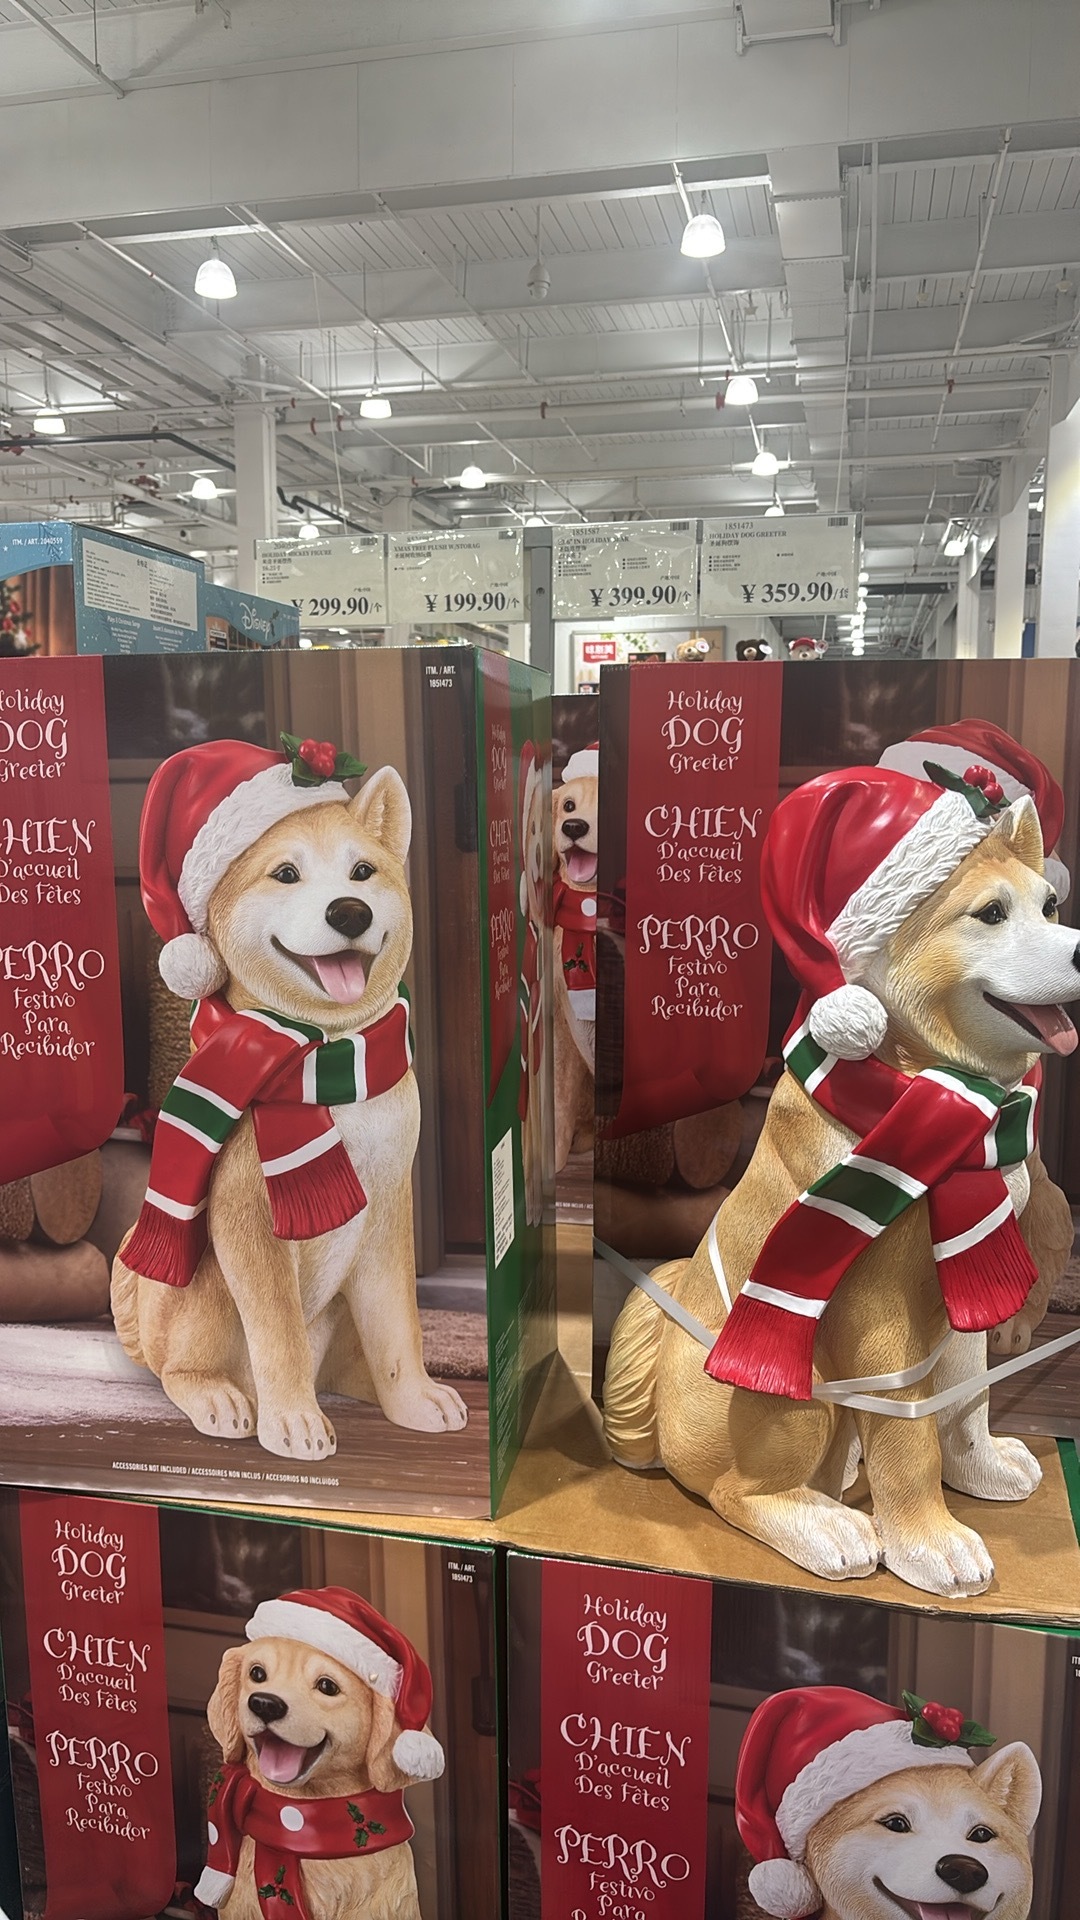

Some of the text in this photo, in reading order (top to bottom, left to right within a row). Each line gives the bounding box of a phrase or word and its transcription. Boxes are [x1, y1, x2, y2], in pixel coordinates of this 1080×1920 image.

[725, 522, 754, 530] 1851473
[424, 594, 438, 612] ¥
[590, 588, 604, 607] ¥
[741, 584, 756, 604] ¥
[426, 666, 438, 674] ITM.
[443, 665, 456, 674] ART.
[430, 678, 452, 688] 1851473
[0, 688, 64, 716] oliday
[668, 690, 742, 715] Holiday
[661, 715, 744, 754] DOG
[0, 758, 66, 782] Greeter
[670, 752, 738, 774] Greeter
[645, 804, 762, 840] CHIEN
[0, 817, 96, 856] HIEN
[656, 840, 744, 861] D'accueil
[656, 862, 742, 883] Des Fêtes
[36, 882, 82, 905] Fêtes
[637, 914, 759, 960] PERRO
[0, 940, 104, 992] ERRO
[668, 956, 728, 976] Festivo
[13, 986, 76, 1009] Festivo
[674, 976, 720, 998] Para
[651, 995, 743, 1022] Recibidor
[22, 1010, 71, 1035] Para
[0, 1032, 96, 1060] Recibidor
[112, 1462, 148, 1471] ACCESSORIES
[160, 1465, 187, 1474] INCLUDED
[192, 1468, 228, 1478] ACCESSOIRES
[241, 1471, 261, 1480] INCLUS
[266, 1473, 300, 1483] ACCESORIOS
[300, 1476, 308, 1484] NO
[310, 1476, 339, 1486] INCLUIDOS
[54, 1520, 124, 1552] Holiday
[52, 1544, 126, 1589] DOG
[464, 1564, 476, 1573] ART.
[61, 1580, 124, 1604] Greeter
[584, 1594, 667, 1632] Holiday
[43, 1628, 151, 1672] CHIEN
[577, 1621, 669, 1674] DOG
[57, 1662, 137, 1693] D'accueil
[586, 1660, 664, 1690] Greeter
[58, 1684, 137, 1714] Des Fêtes
[560, 1713, 691, 1767] CHIEN
[46, 1730, 158, 1785] PERRO
[574, 1751, 671, 1790] D'accueil
[77, 1772, 132, 1797] Festivo
[574, 1774, 670, 1812] Des Fêtes
[85, 1792, 128, 1819] Para
[65, 1808, 150, 1842] Recibidor
[554, 1824, 690, 1889] PERRO
[589, 1870, 655, 1901] Festivo
[597, 1894, 646, 1920] Para
